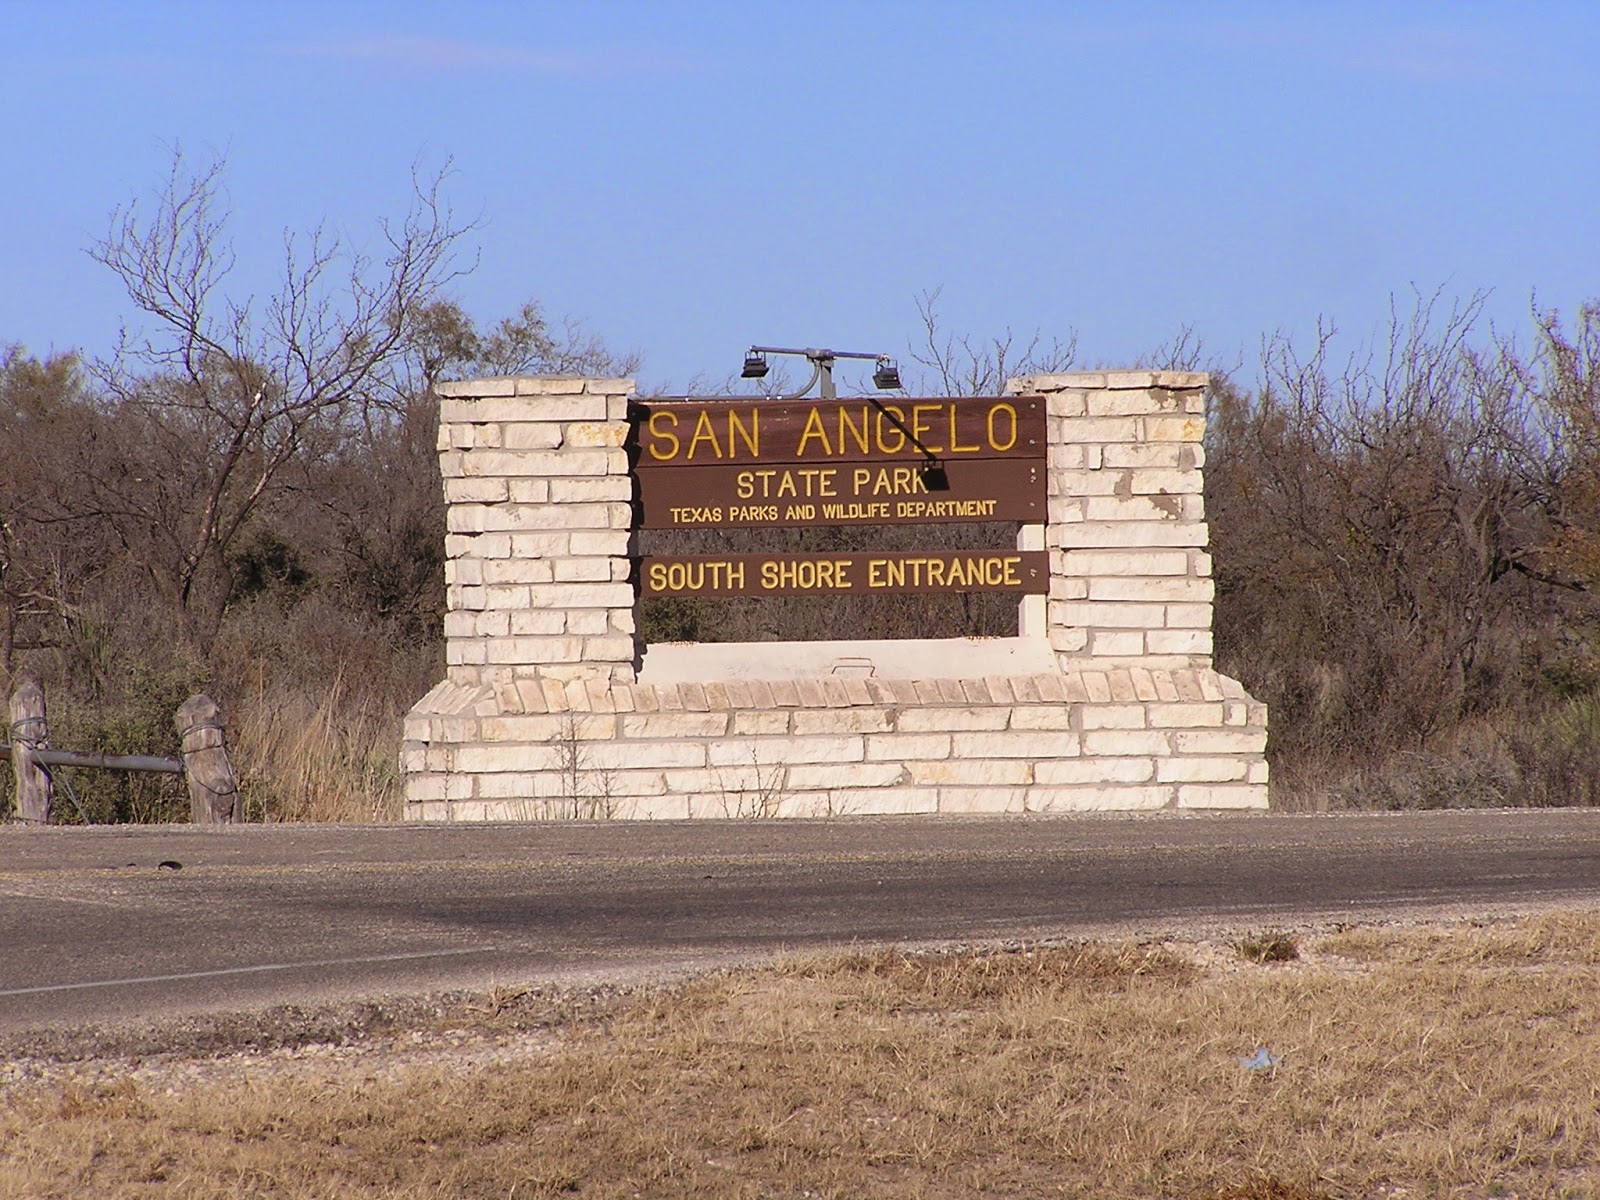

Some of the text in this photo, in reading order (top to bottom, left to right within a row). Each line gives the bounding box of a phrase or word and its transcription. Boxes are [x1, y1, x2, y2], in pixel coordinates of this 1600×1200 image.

[649, 403, 1018, 460] SAN ANGELO
[737, 467, 930, 499] STATE PARK
[669, 499, 997, 523] TEXAS PARKS AND WILDLIFE DEPARTMENT
[649, 556, 1022, 592] SOUTH SHORE ENTRANCE
